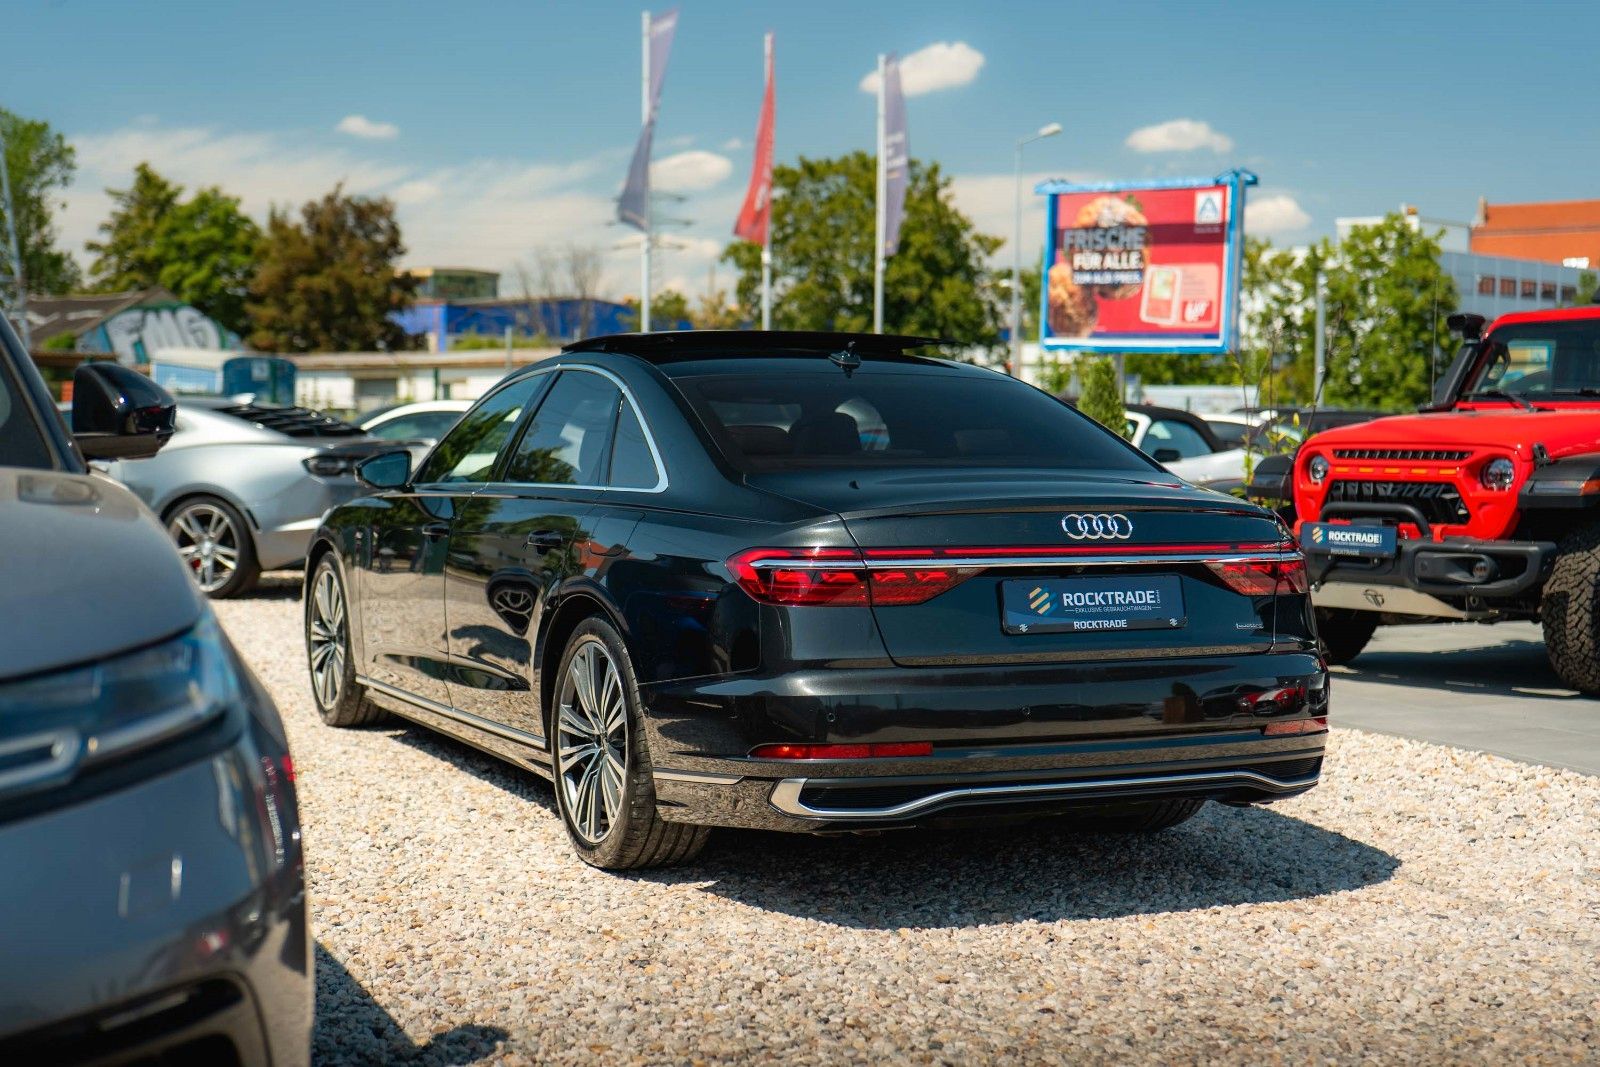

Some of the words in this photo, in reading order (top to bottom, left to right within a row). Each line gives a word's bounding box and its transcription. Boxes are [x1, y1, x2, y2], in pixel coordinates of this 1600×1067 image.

[1064, 227, 1145, 250] FRISCHE
[1073, 249, 1103, 270] FÜR
[1328, 530, 1379, 544] ROCKTRADE
[1063, 591, 1155, 606] ROCKTRADE
[1075, 606, 1103, 614] EXKLUSIVE
[1103, 605, 1152, 613] GEBRAUCHTWAGEN
[1073, 619, 1128, 630] ROCKTRADE
